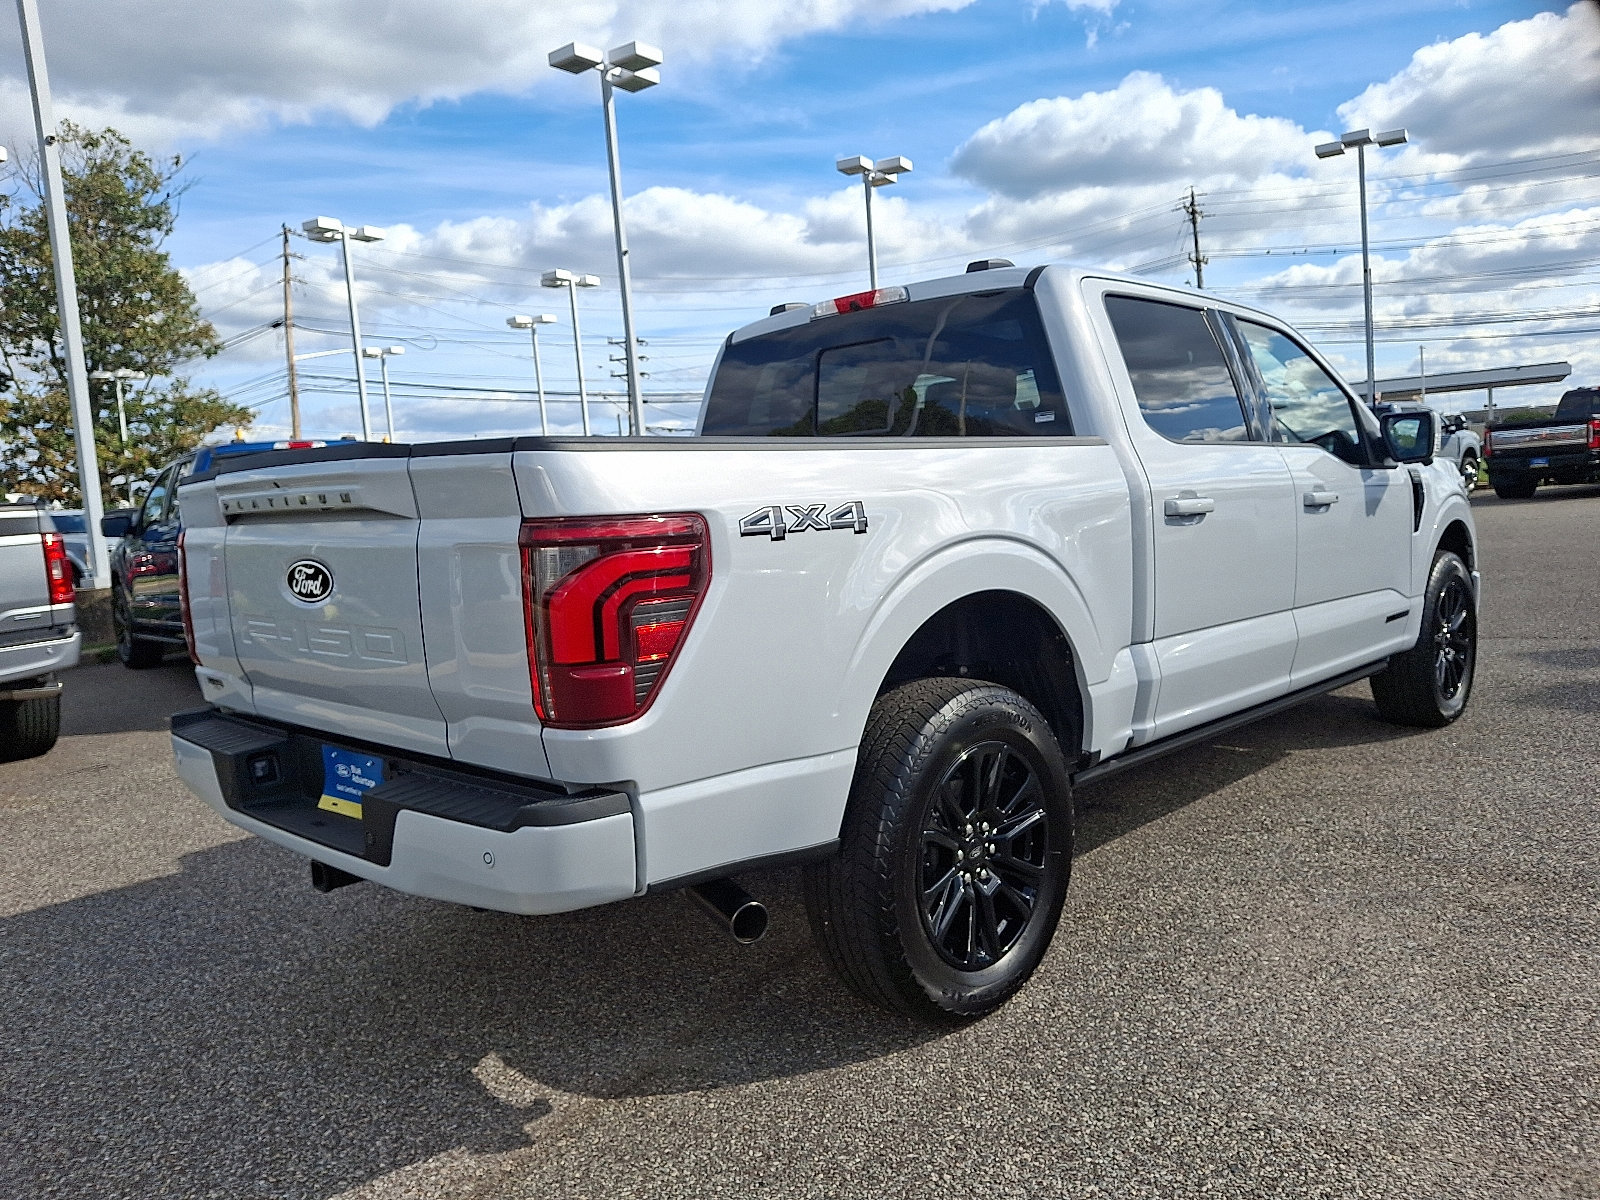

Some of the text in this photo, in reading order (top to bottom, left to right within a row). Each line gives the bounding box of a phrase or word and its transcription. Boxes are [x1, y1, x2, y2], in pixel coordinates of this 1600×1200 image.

[223, 492, 352, 511] PLATINUM
[739, 501, 868, 541] 4X4
[292, 565, 323, 596] Ford
[242, 614, 408, 664] F-150
